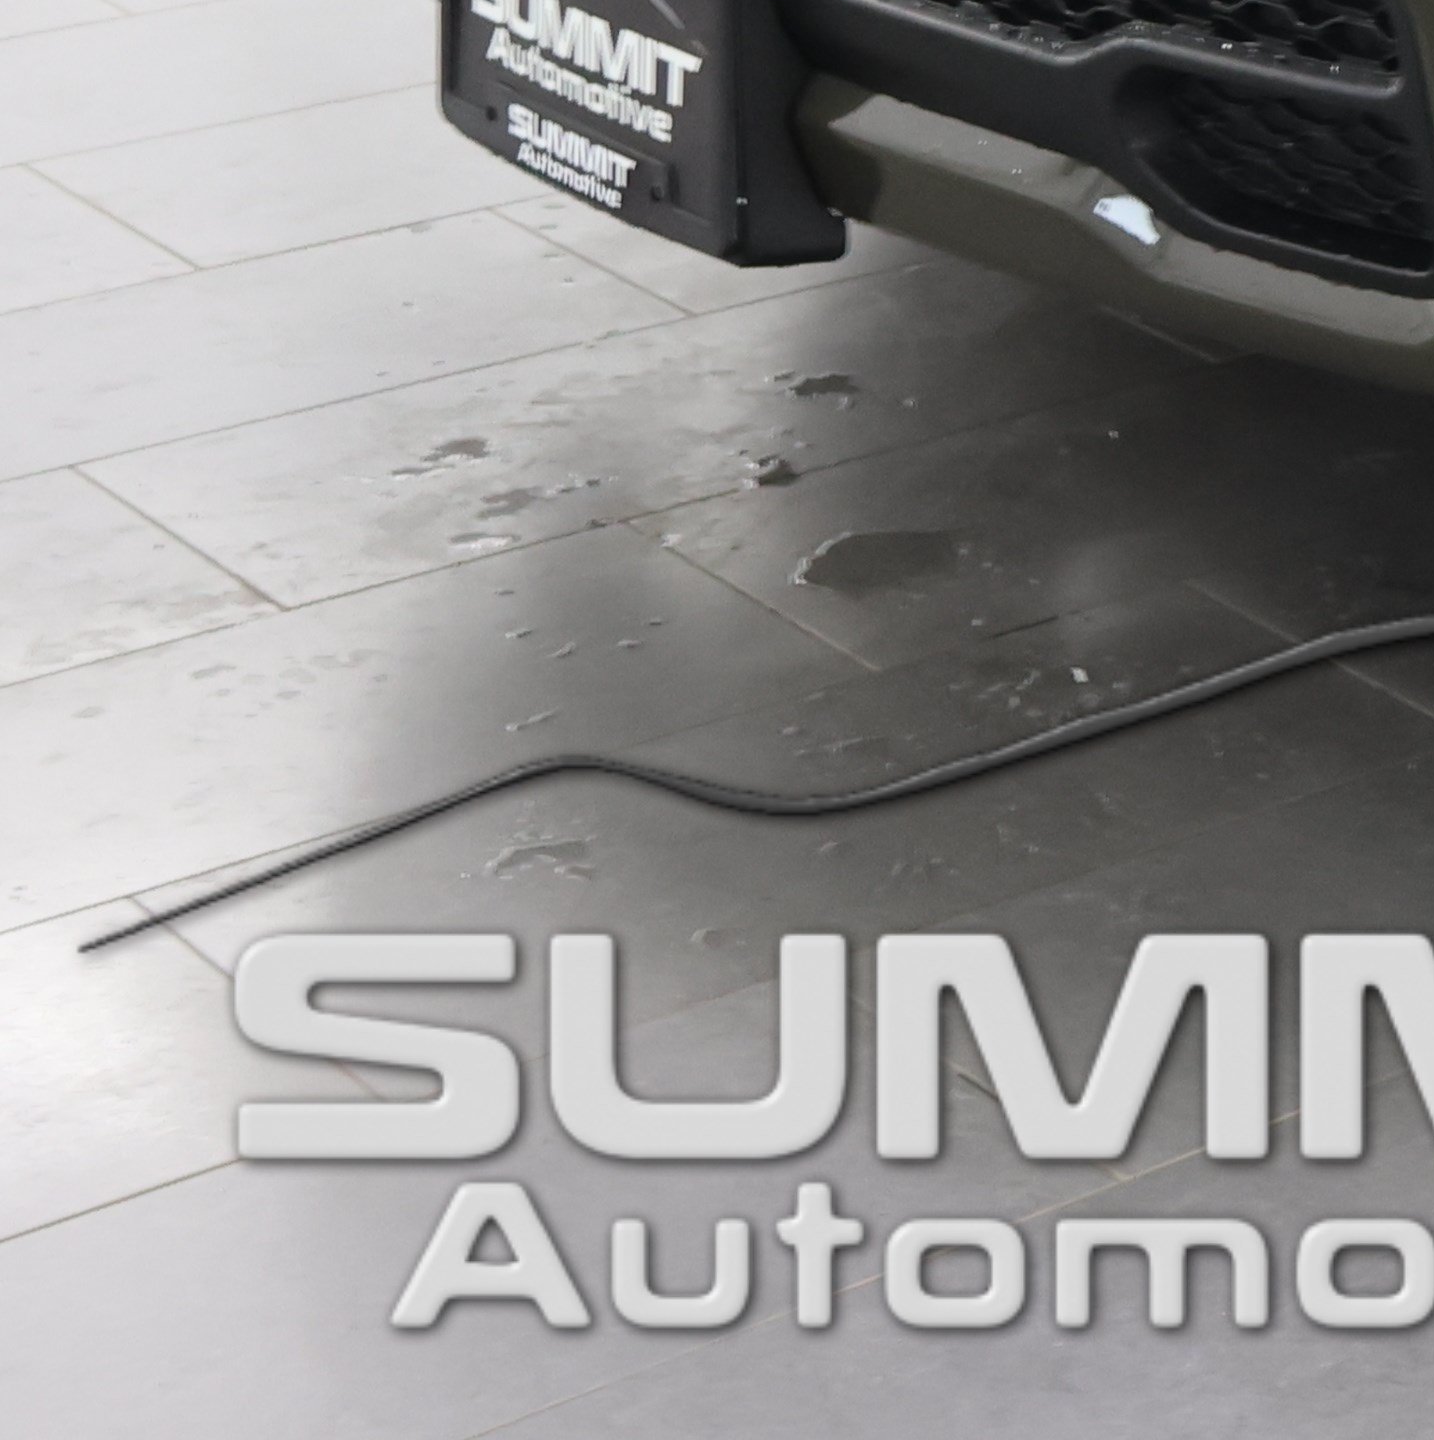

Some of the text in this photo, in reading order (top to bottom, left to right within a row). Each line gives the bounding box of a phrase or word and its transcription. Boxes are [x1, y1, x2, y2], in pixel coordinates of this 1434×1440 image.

[485, 27, 674, 143] Automotive
[507, 102, 637, 189] SUMMIT
[516, 141, 623, 209] Automotive
